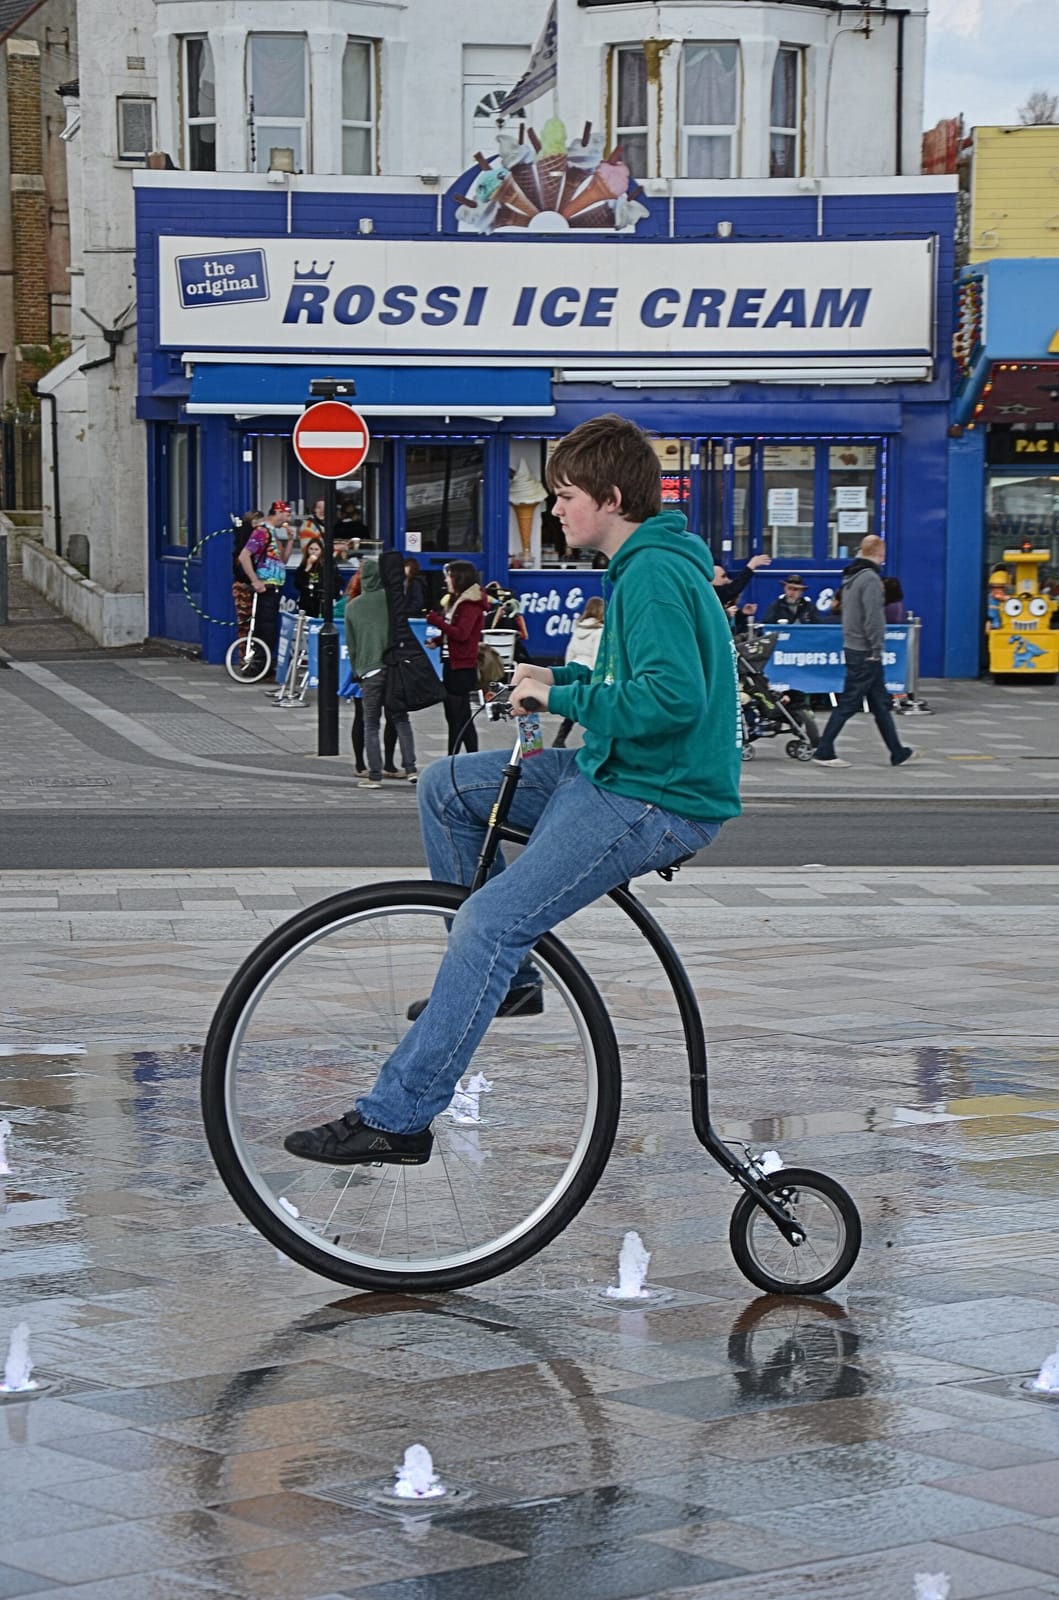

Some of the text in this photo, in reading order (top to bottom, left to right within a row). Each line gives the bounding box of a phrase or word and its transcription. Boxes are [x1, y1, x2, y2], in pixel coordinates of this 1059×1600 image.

[203, 262, 235, 277] the
[186, 274, 258, 296] original
[282, 284, 872, 329] ROSSI ICE CREAM
[1015, 439, 1049, 452] PAC
[519, 587, 583, 614] Fish &
[545, 612, 580, 636] Chi
[773, 650, 828, 667] Burgers
[828, 651, 840, 665] &
